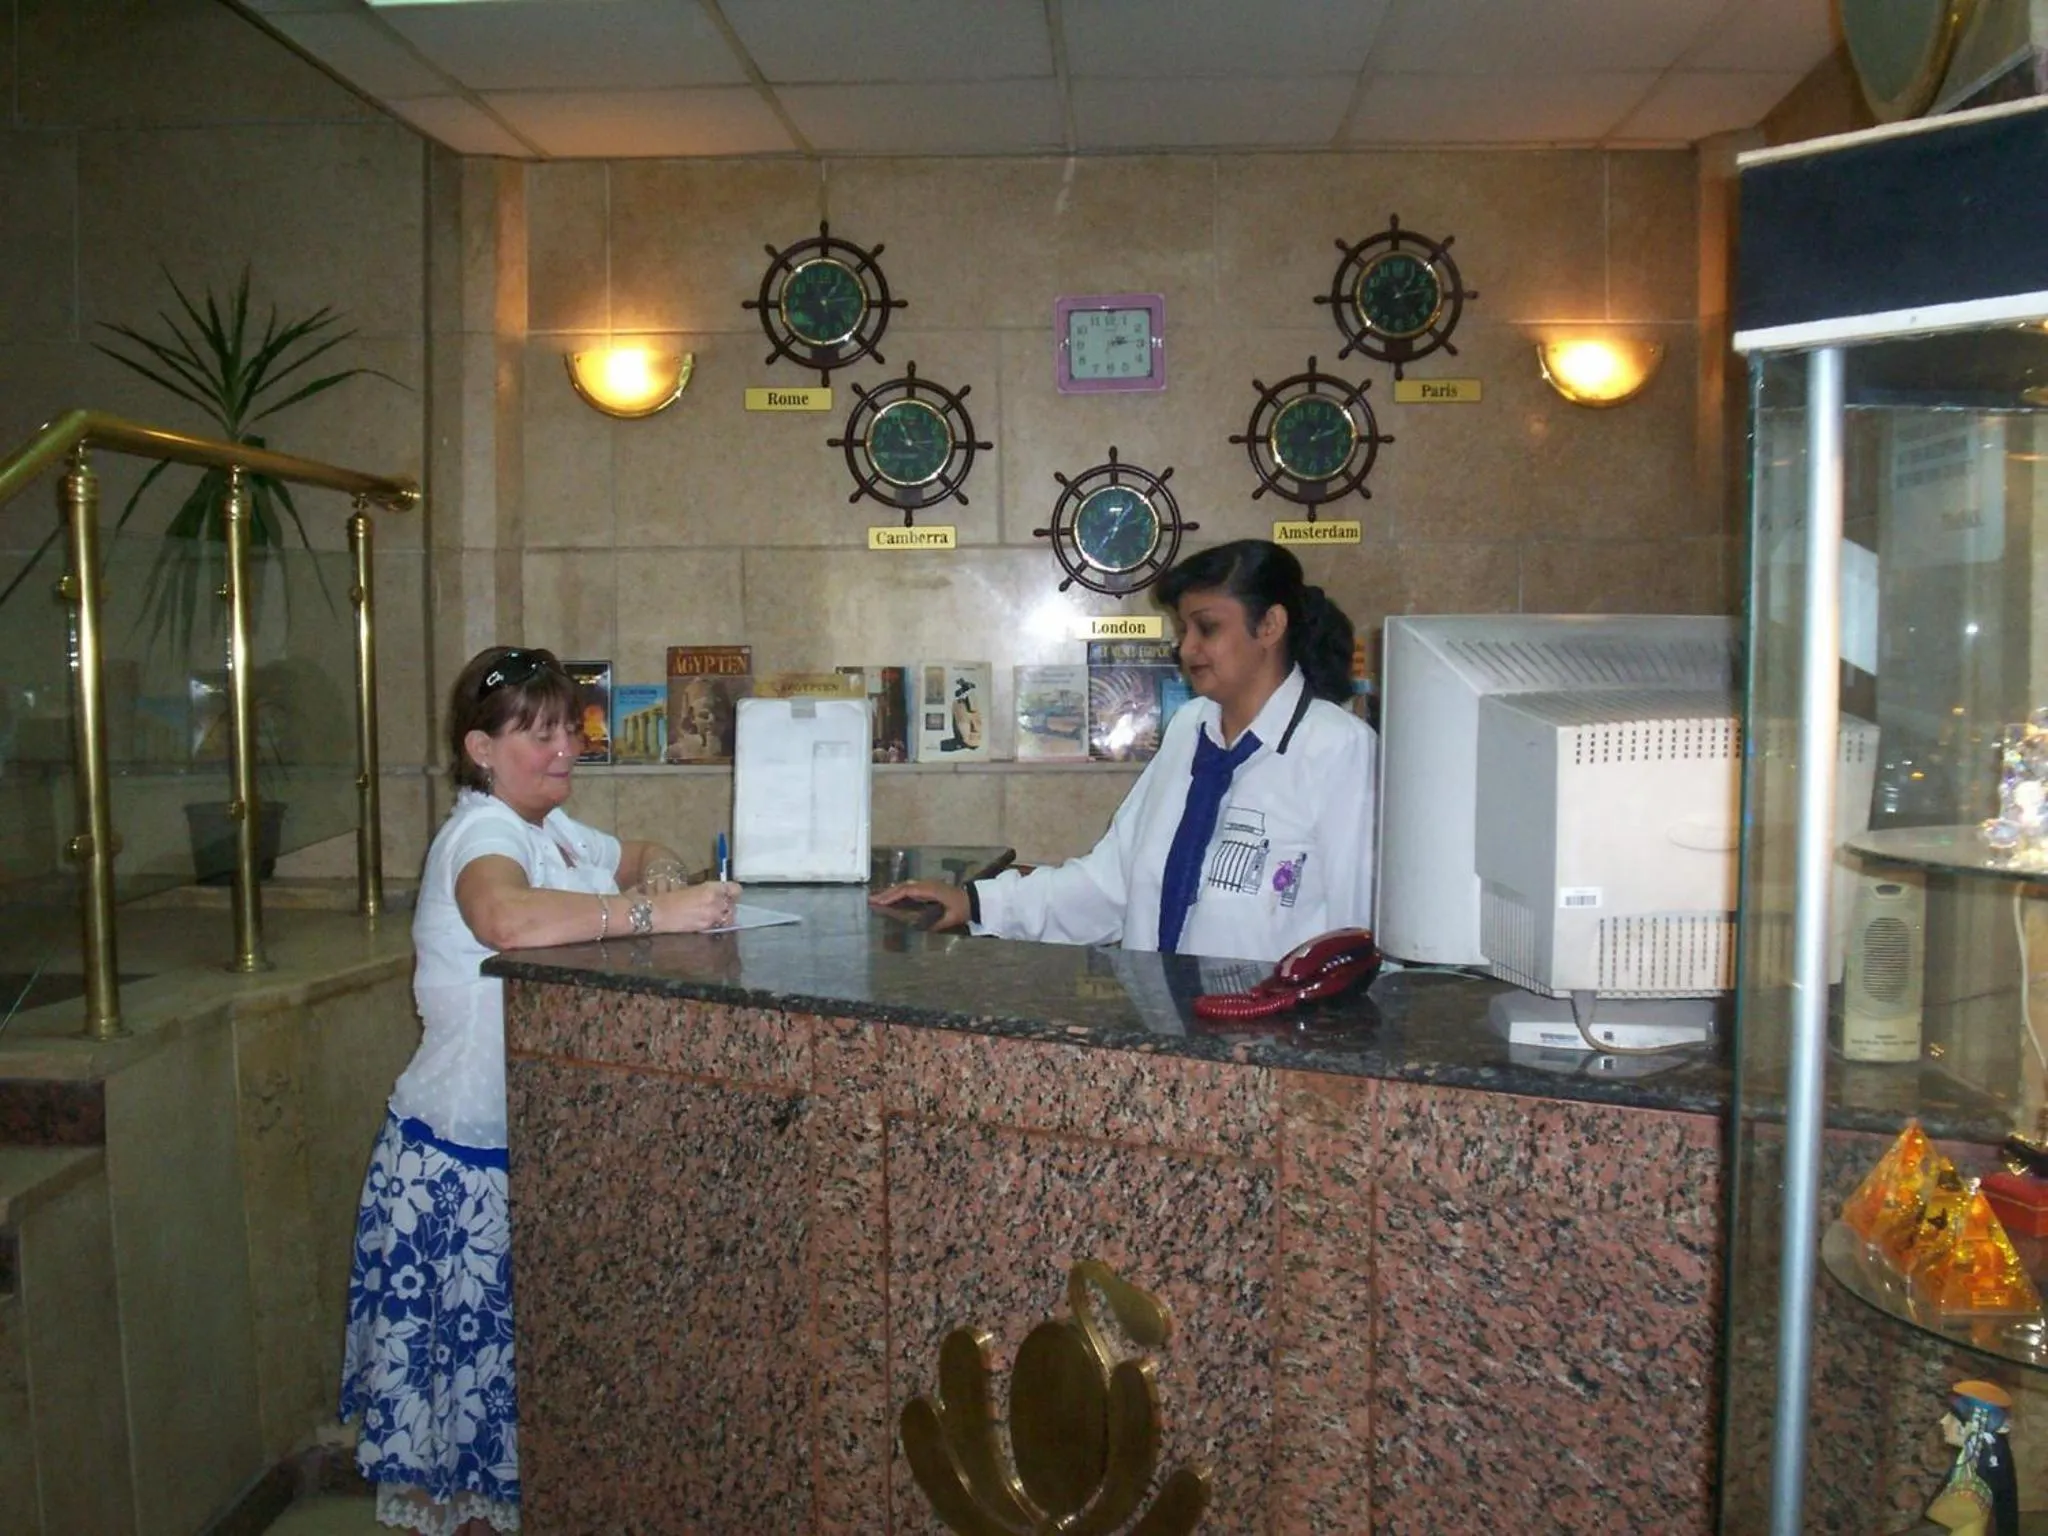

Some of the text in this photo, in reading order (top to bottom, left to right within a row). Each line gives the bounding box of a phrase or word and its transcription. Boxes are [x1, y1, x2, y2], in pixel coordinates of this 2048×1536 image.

[1421, 382, 1458, 398] Paris
[767, 392, 809, 405] Rome
[1278, 525, 1359, 539] Amsterdam
[1091, 620, 1147, 634] London
